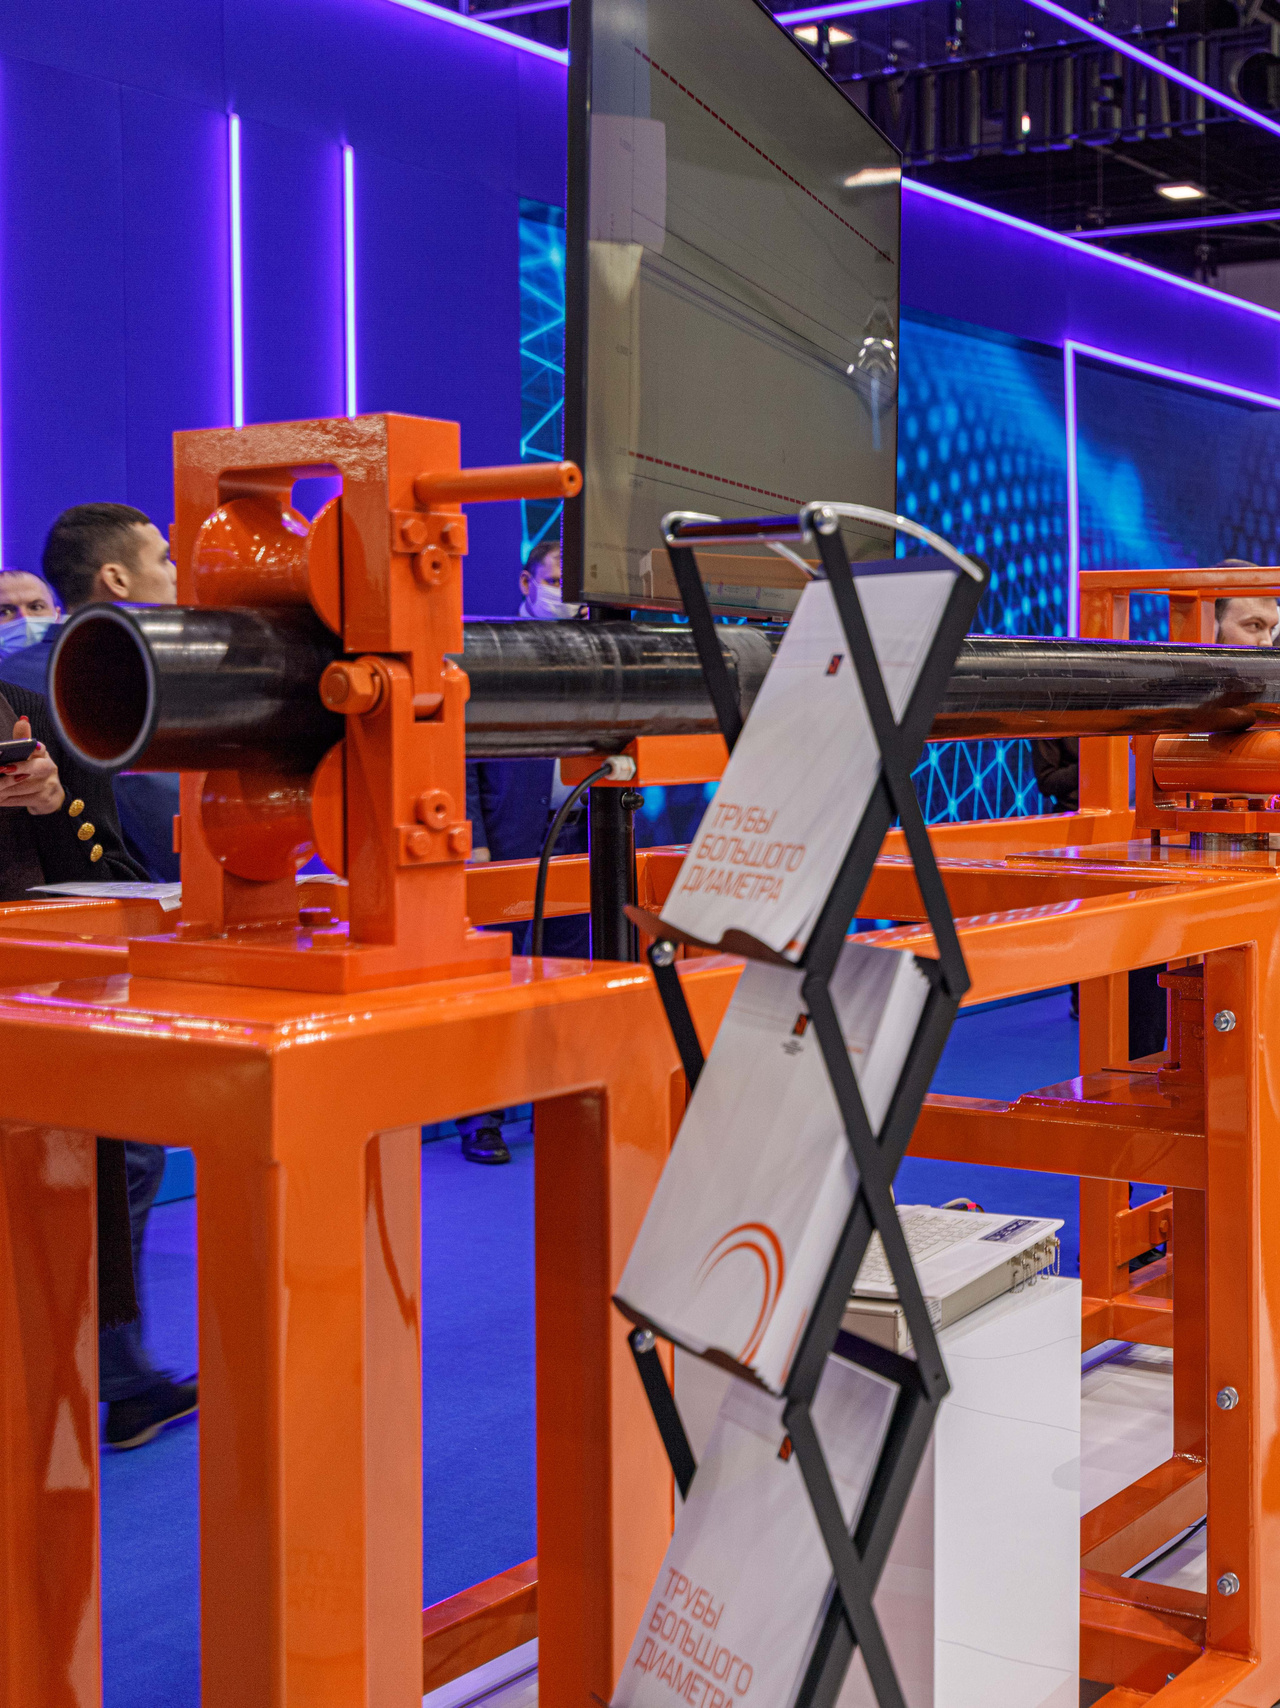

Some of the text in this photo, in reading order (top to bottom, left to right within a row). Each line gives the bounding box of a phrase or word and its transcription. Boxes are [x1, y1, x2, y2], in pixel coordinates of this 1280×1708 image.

[711, 802, 778, 834] ТРУБЫ
[696, 833, 806, 873] БОЛЬШОГО
[680, 865, 784, 902] ДИАМЕТРА
[664, 1566, 725, 1631] ТРУБЫ
[648, 1601, 754, 1696] БОЛЬШОГО
